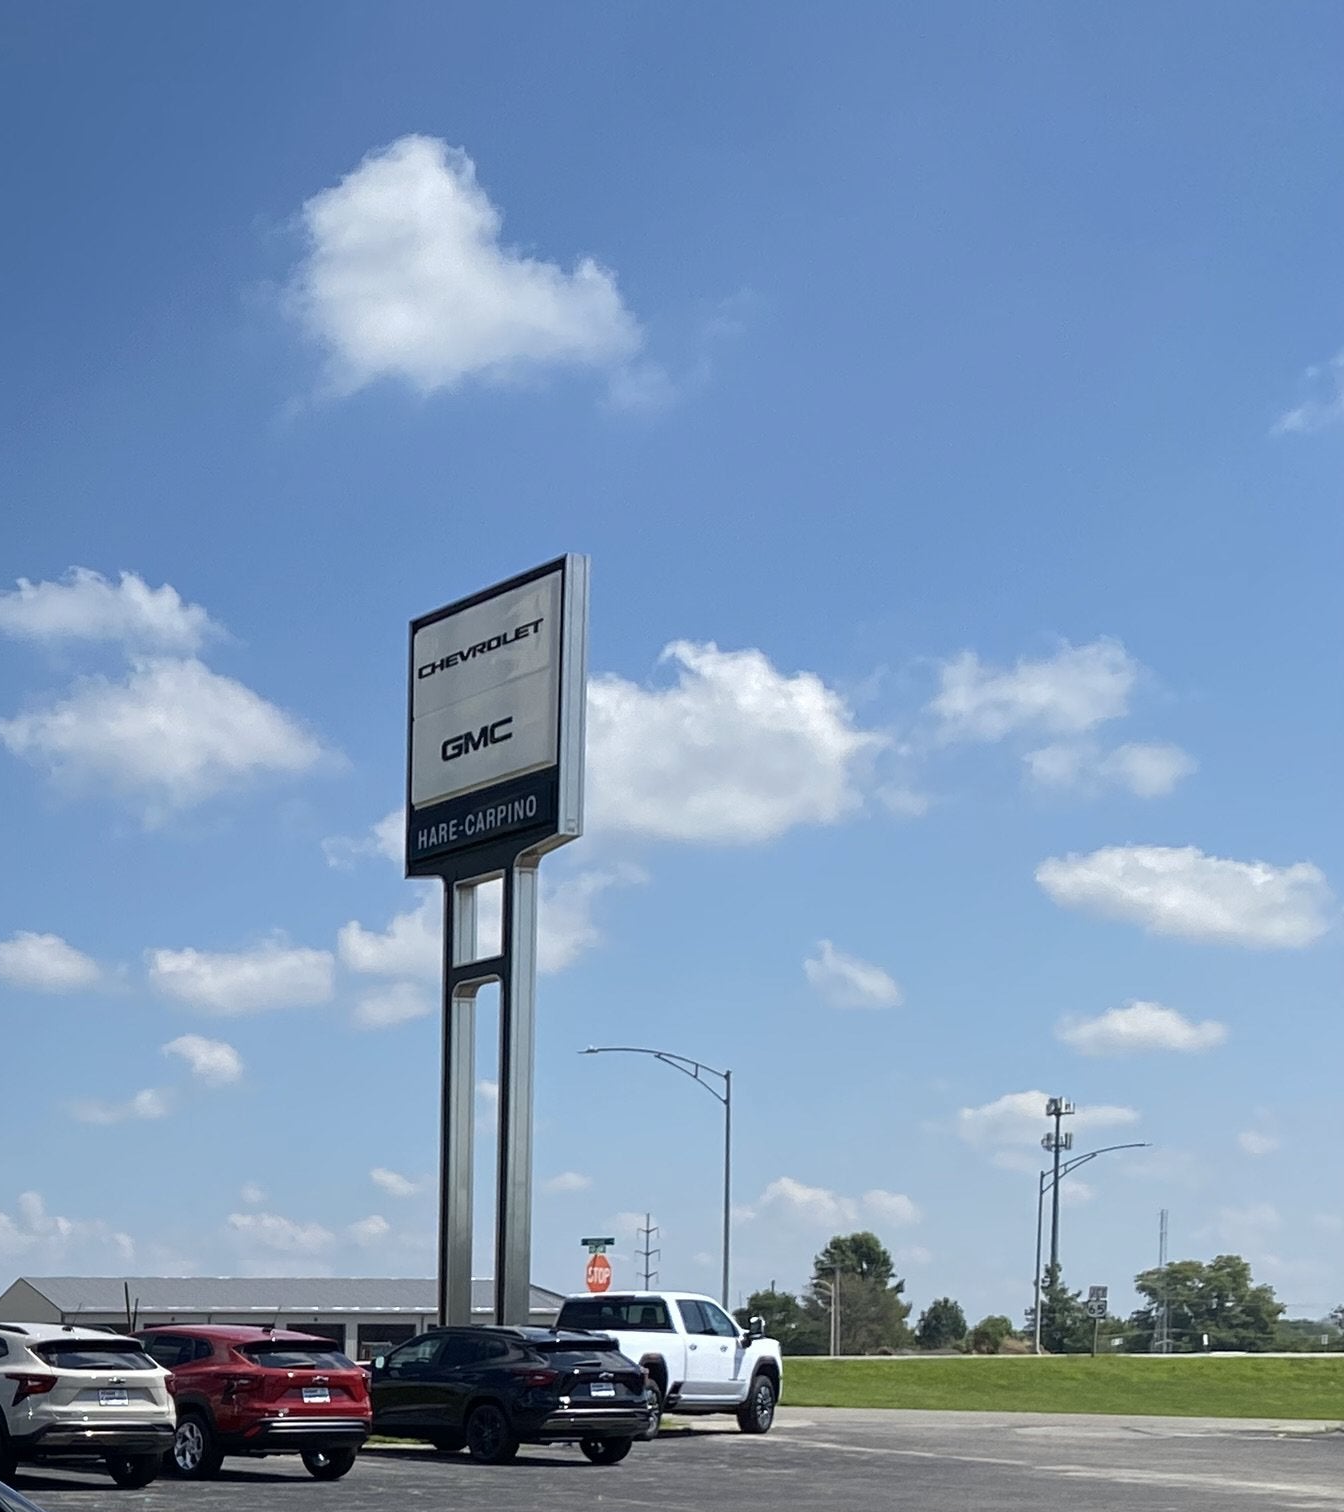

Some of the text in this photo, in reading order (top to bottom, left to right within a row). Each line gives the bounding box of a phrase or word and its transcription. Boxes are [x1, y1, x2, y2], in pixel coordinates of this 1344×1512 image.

[417, 618, 544, 680] CHEVROLET
[441, 716, 513, 762] GMC
[417, 795, 538, 850] HARE-CARPINO
[588, 1266, 610, 1284] STOP
[1088, 1304, 1105, 1315] 65
